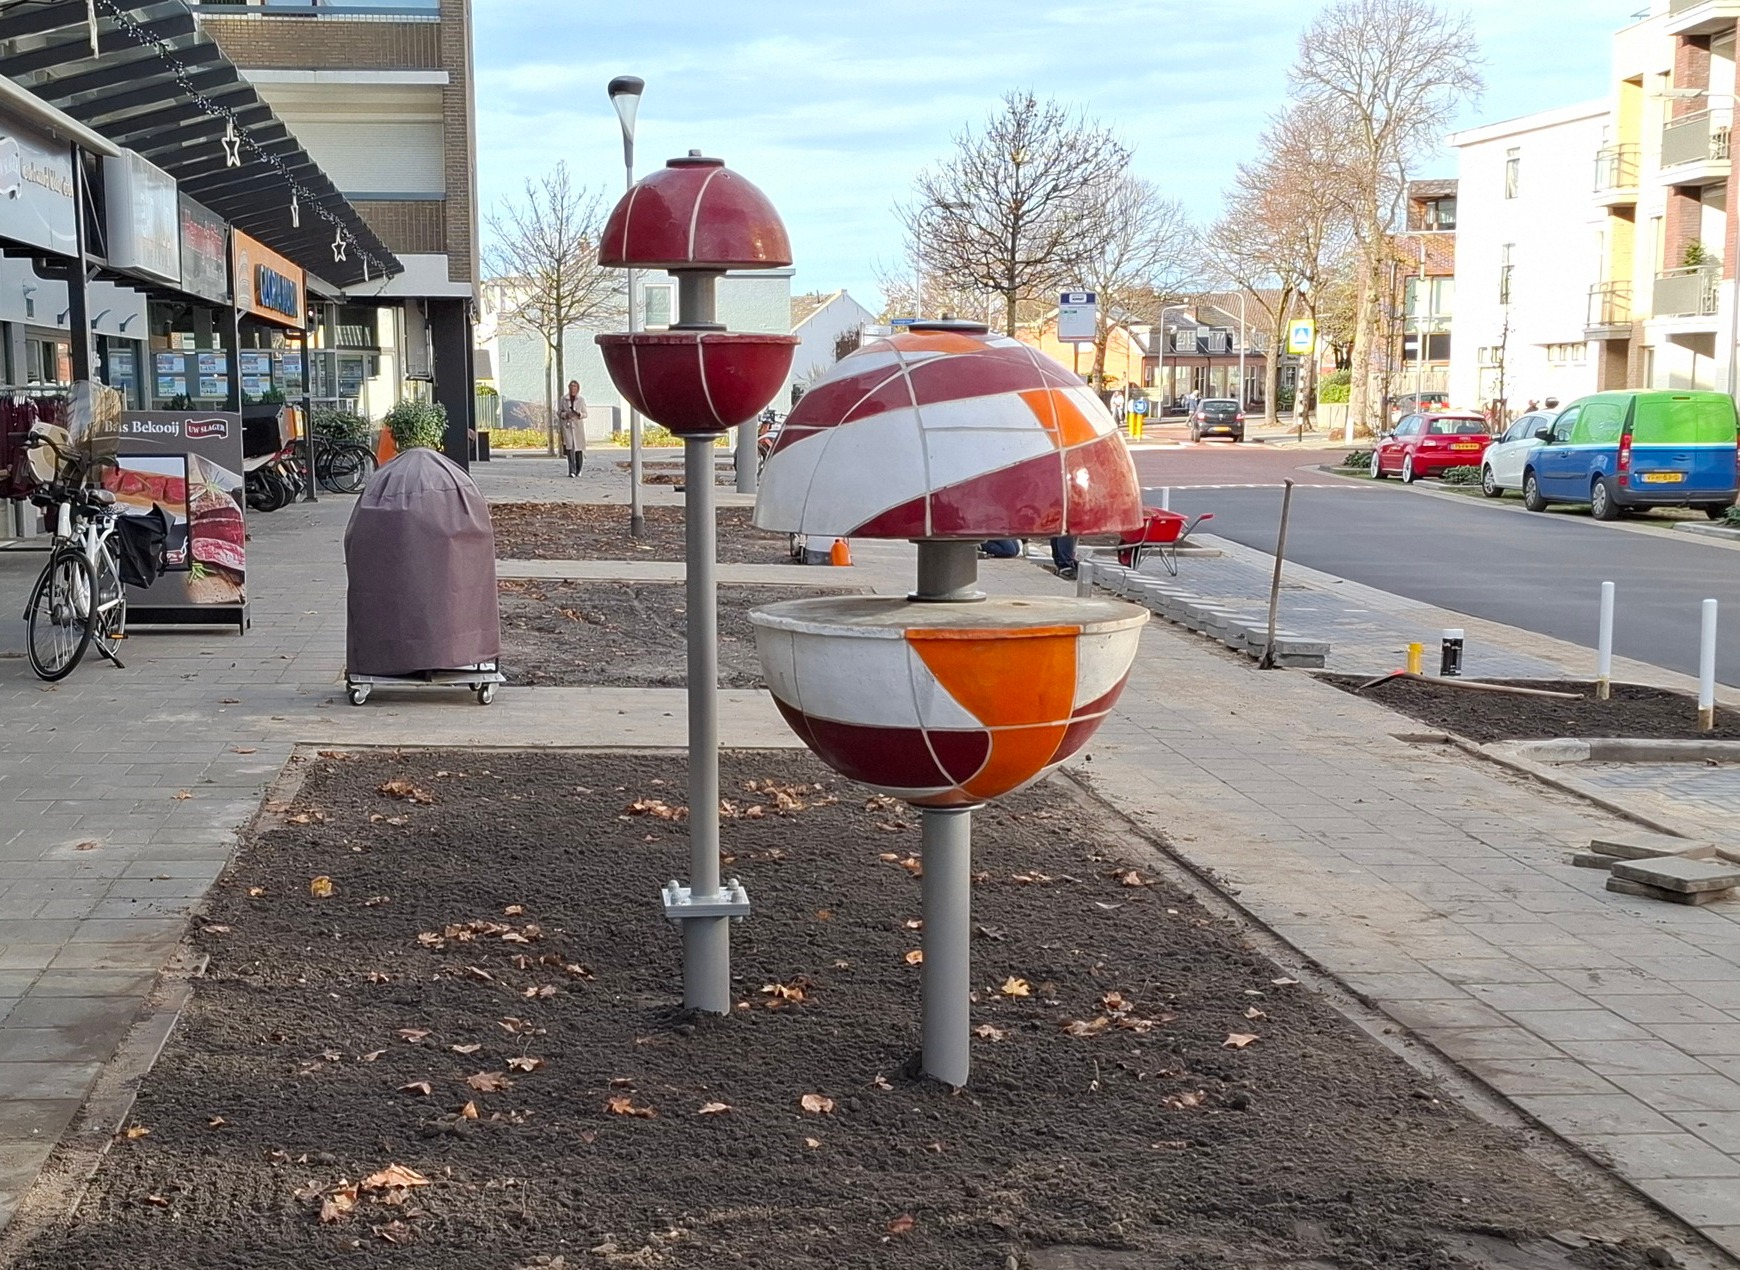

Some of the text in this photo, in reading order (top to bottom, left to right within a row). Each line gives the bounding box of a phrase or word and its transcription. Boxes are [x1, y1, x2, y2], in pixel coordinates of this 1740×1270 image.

[132, 420, 180, 437] Bekooij
[188, 423, 226, 434] UW SLAGER
